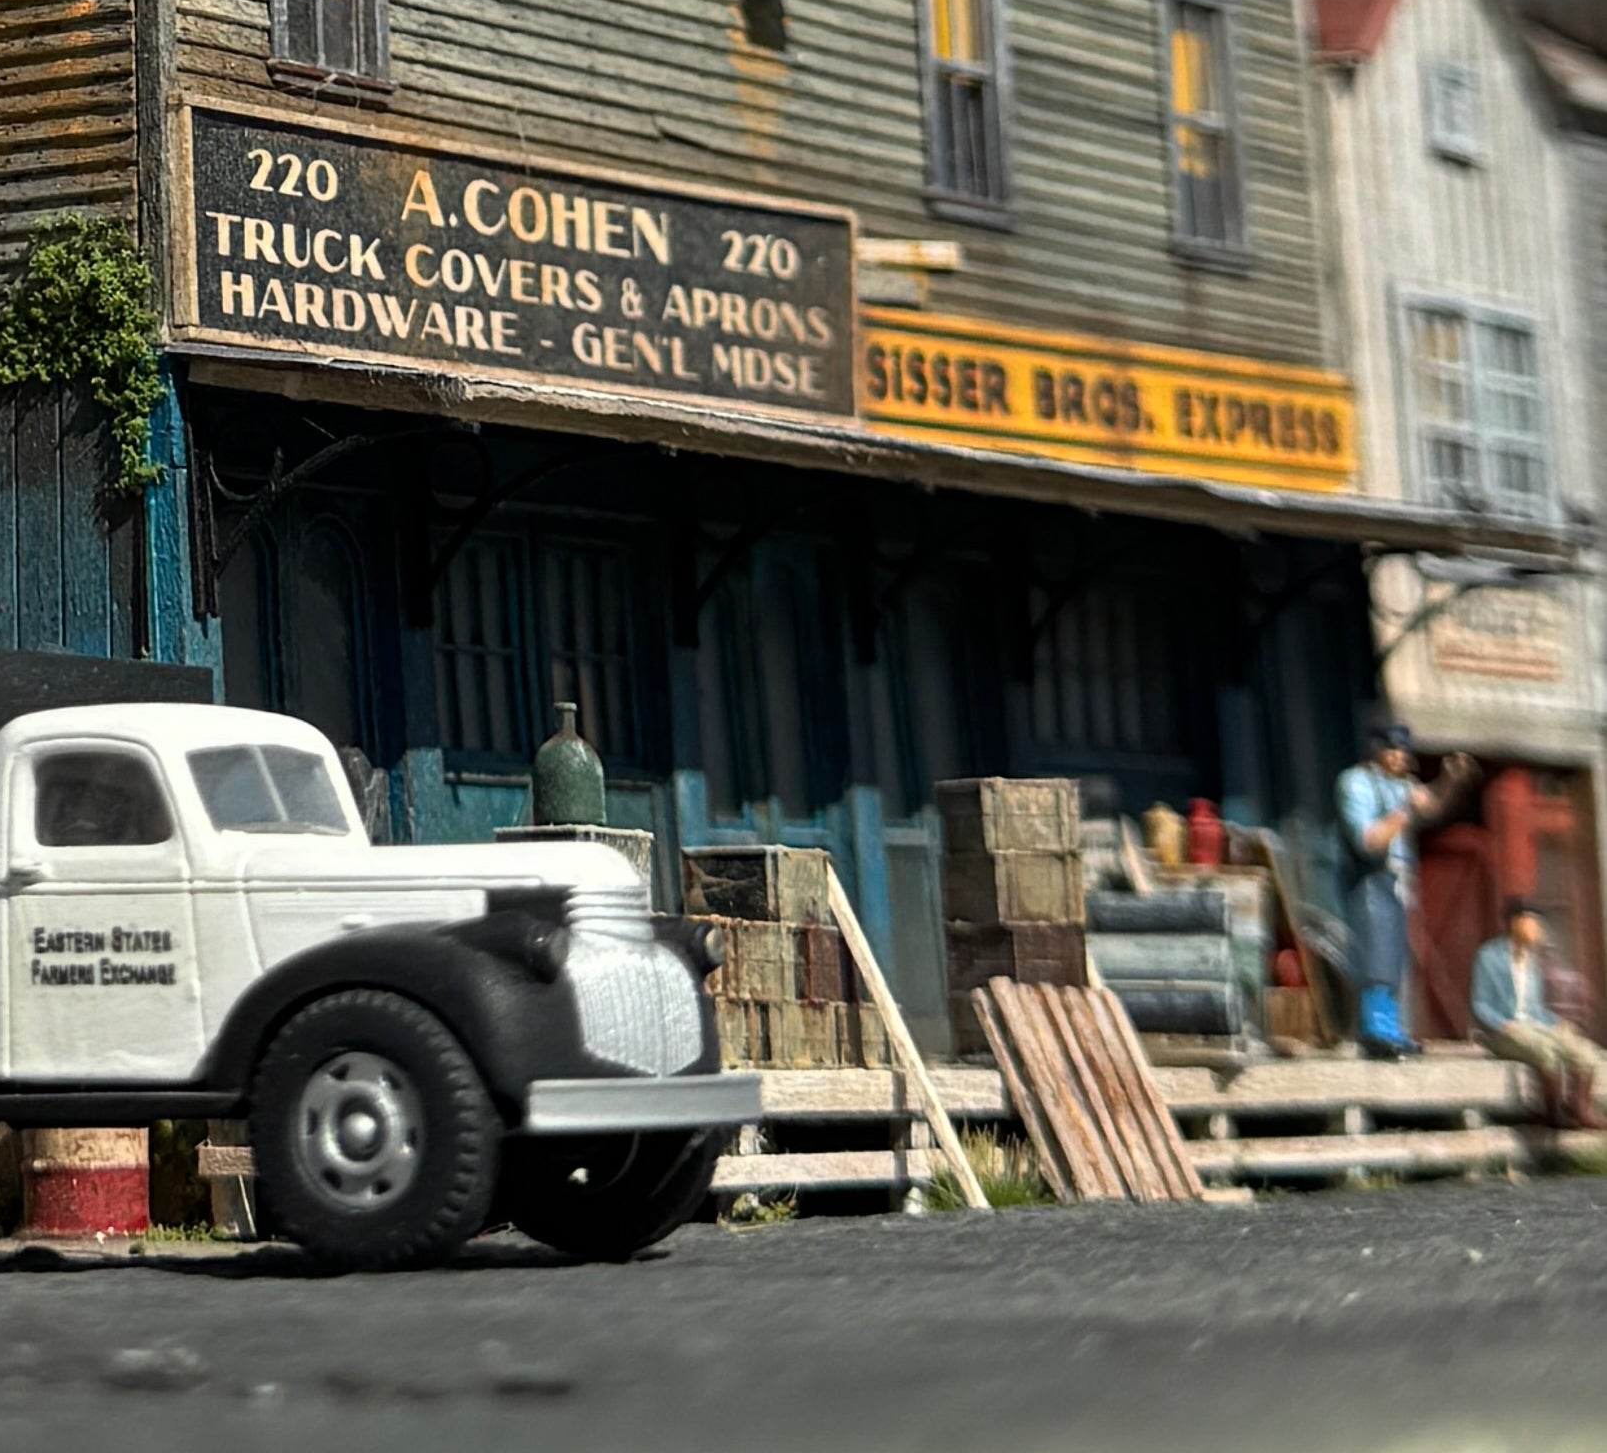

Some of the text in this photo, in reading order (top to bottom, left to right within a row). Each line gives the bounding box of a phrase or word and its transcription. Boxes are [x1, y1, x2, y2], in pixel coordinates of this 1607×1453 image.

[247, 148, 339, 202] 220
[719, 230, 800, 280] 220
[205, 210, 834, 350] TRUCK COVERS & APRONS
[219, 269, 522, 357] HARDWARE
[572, 322, 699, 384] GEN'L
[710, 343, 825, 395] MDSE
[867, 343, 1010, 414] SISSER
[1175, 388, 1340, 456] EXPRESS
